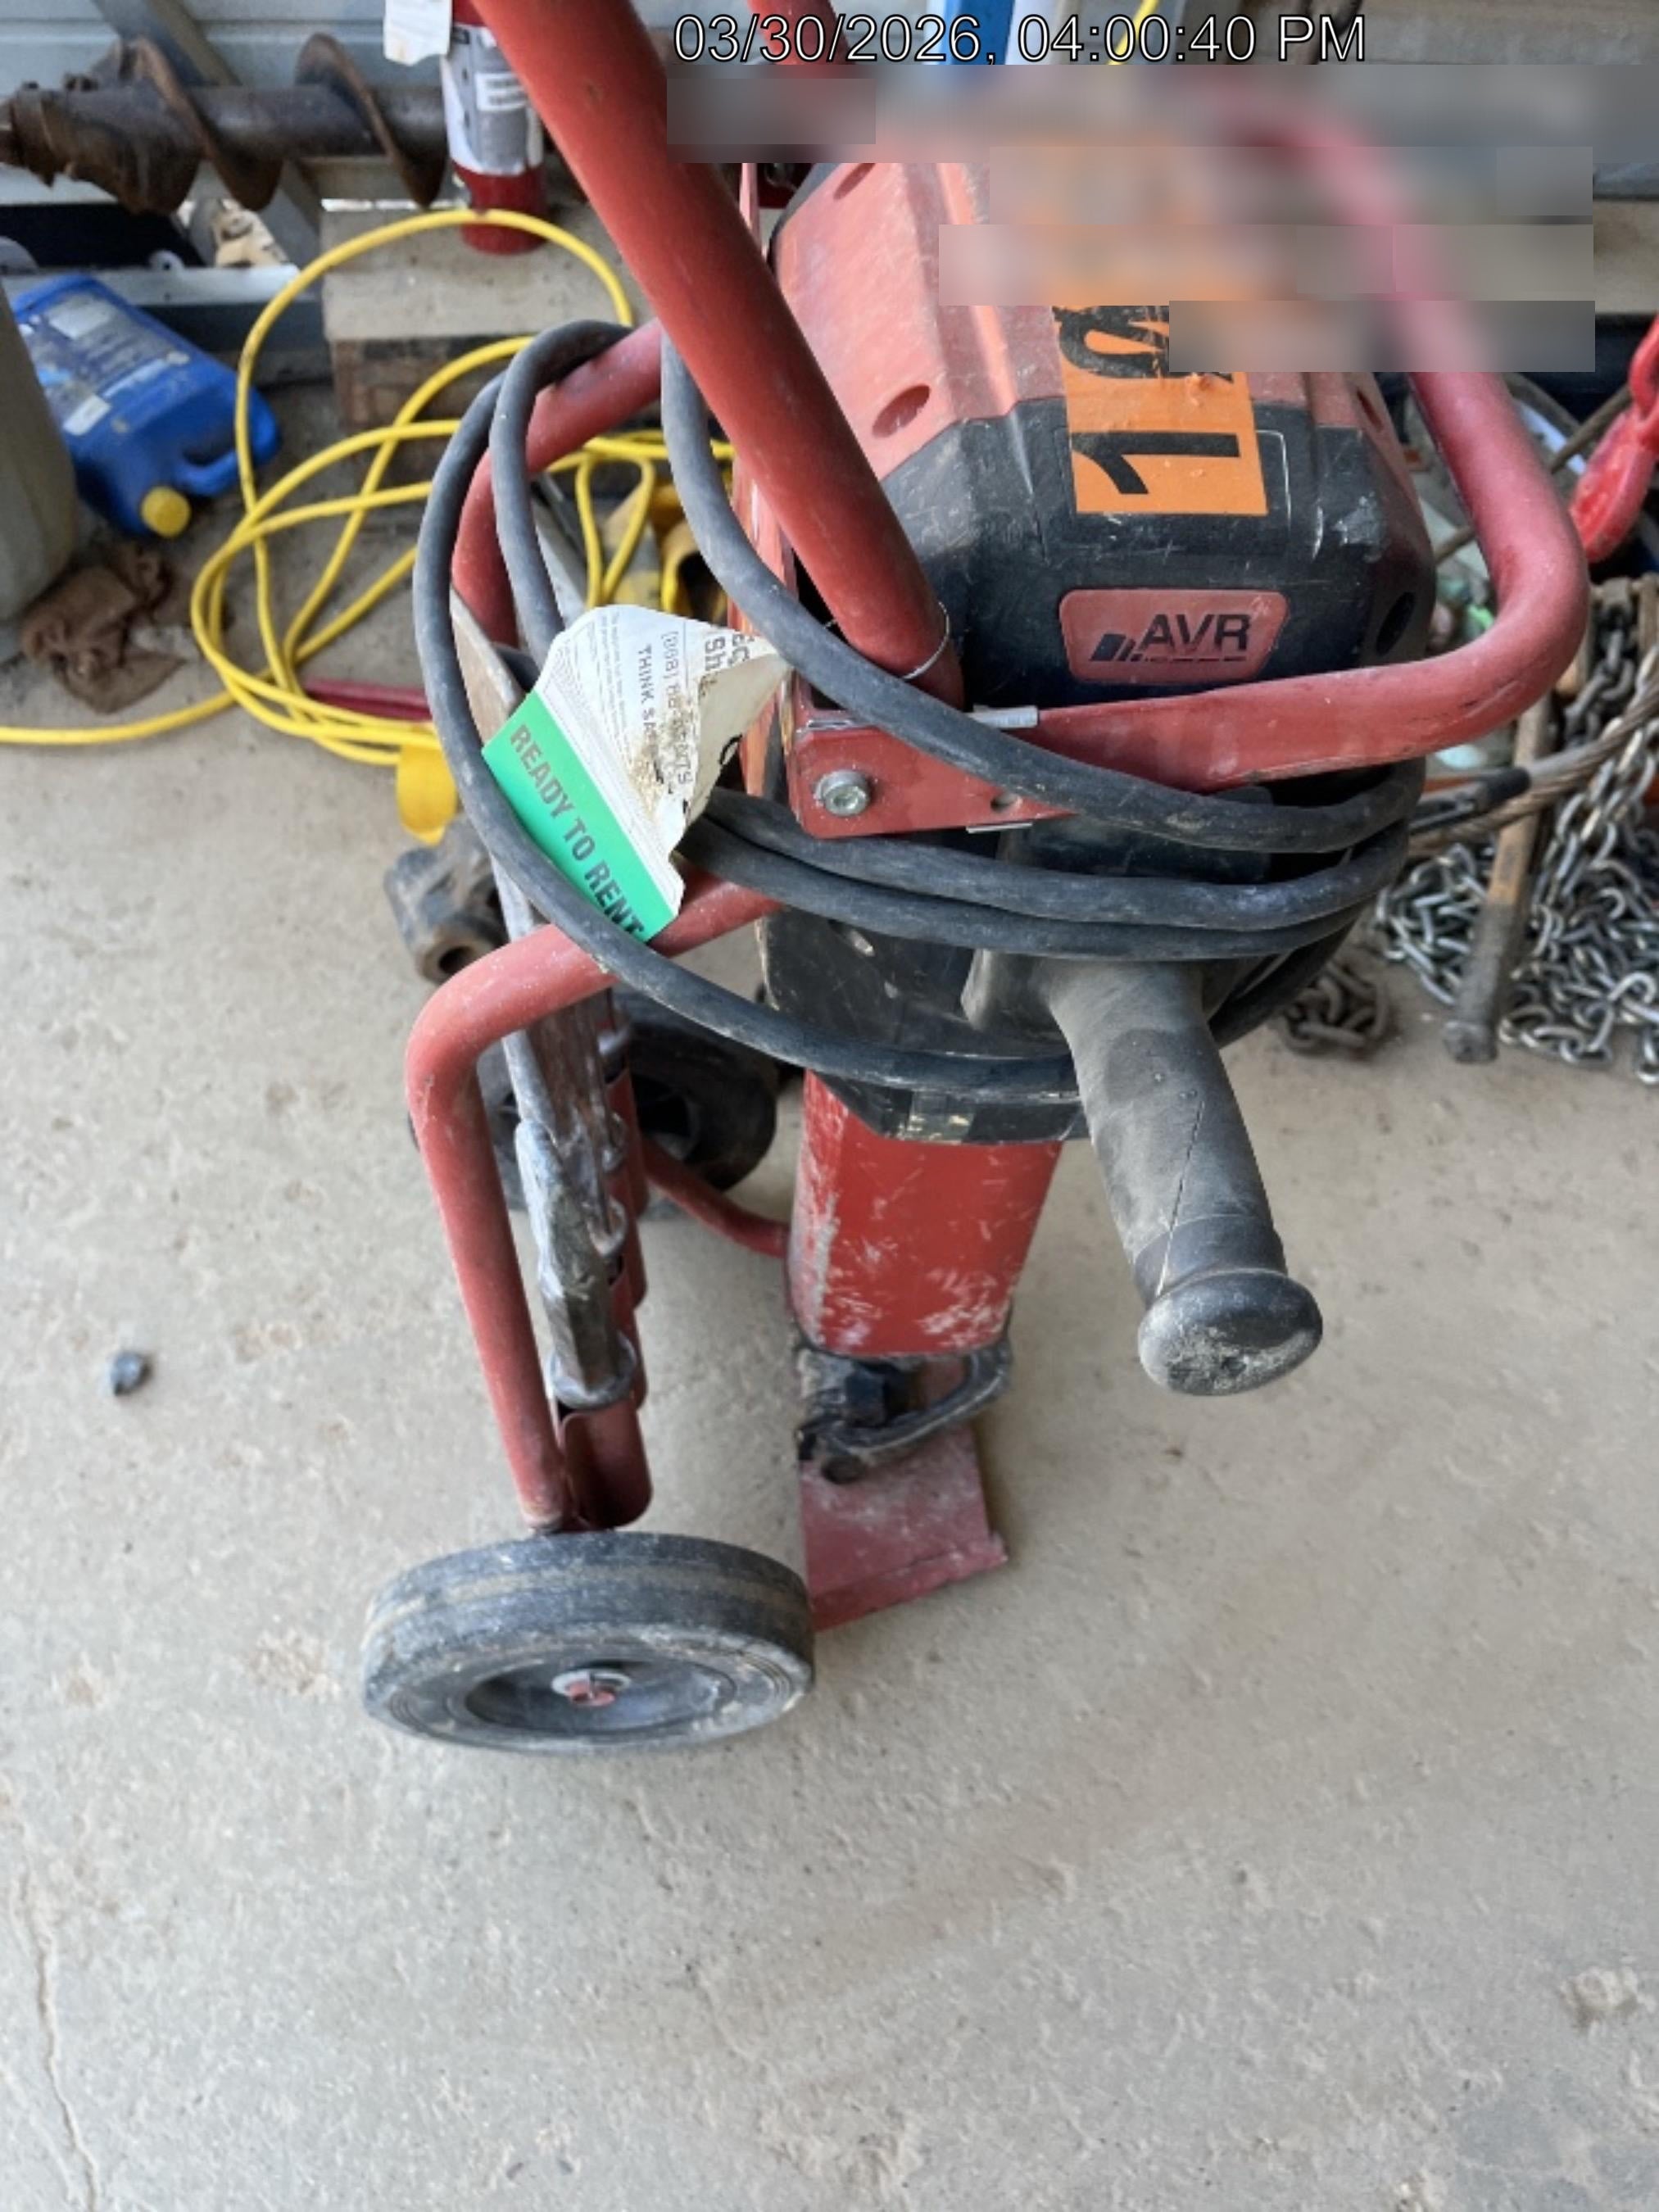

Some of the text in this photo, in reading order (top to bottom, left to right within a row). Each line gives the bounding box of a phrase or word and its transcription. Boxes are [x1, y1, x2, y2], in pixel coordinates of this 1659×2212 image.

[1140, 613, 1251, 652] AVR
[510, 724, 645, 935] READY TO RENT
